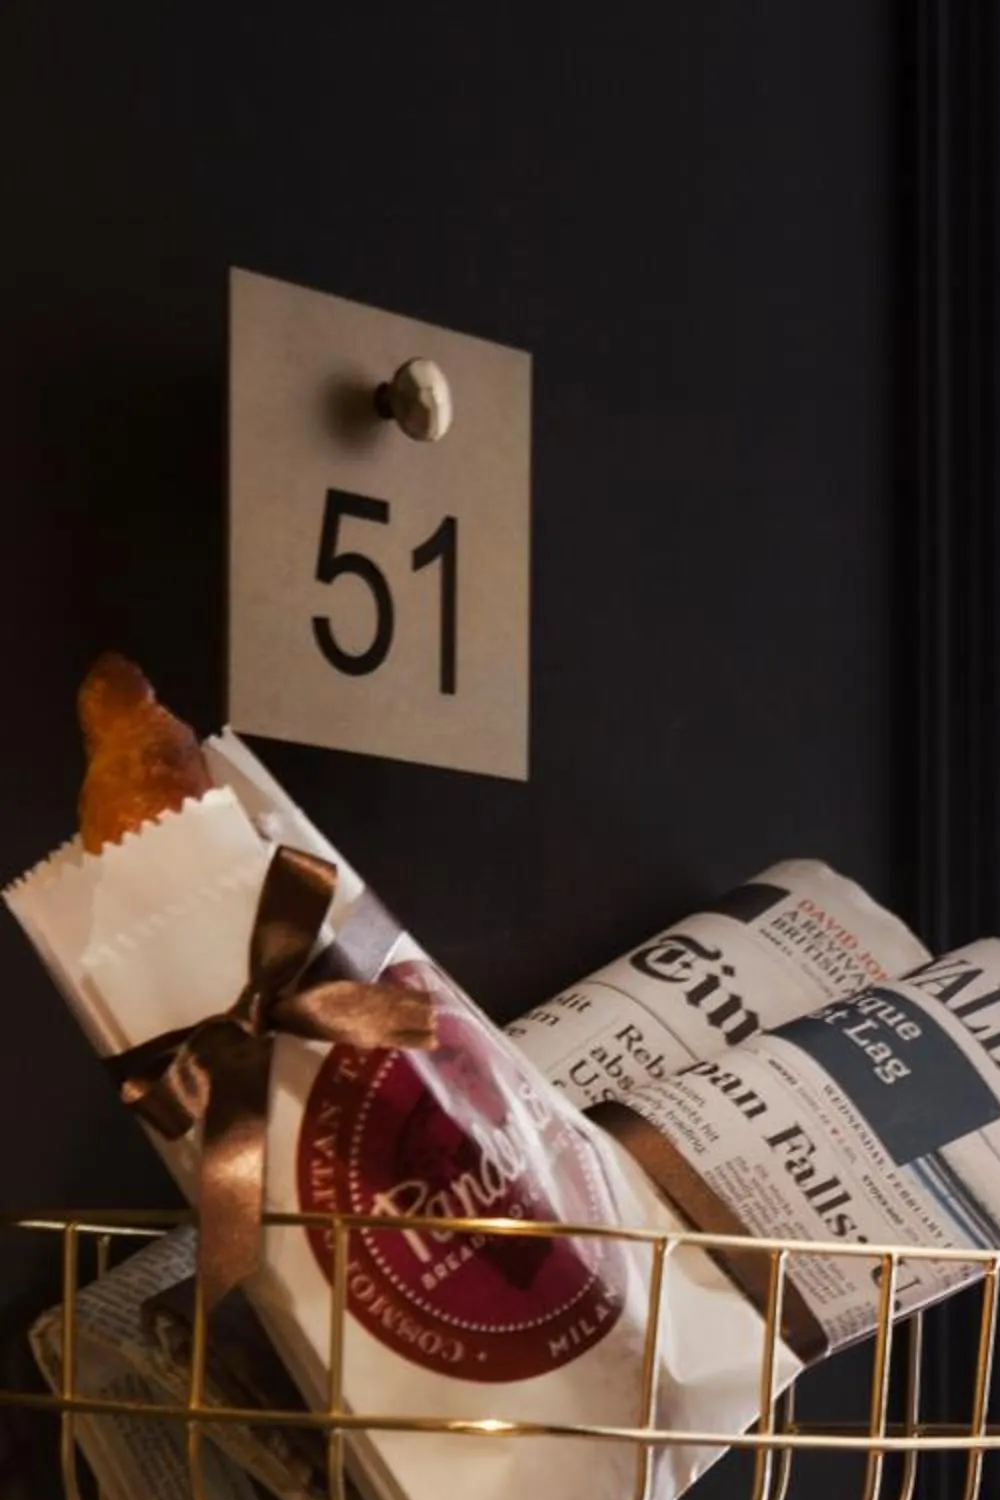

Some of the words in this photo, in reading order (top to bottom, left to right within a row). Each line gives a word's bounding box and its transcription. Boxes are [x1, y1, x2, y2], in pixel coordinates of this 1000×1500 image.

[311, 487, 458, 696] 51
[770, 916, 847, 985] BRITISH
[781, 910, 799, 923] A
[800, 919, 868, 986] REVIVA
[796, 898, 859, 950] DAVID
[589, 1046, 635, 1091] abs
[842, 1017, 912, 1085] Lag
[310, 1100, 466, 1364] COSMOITAN
